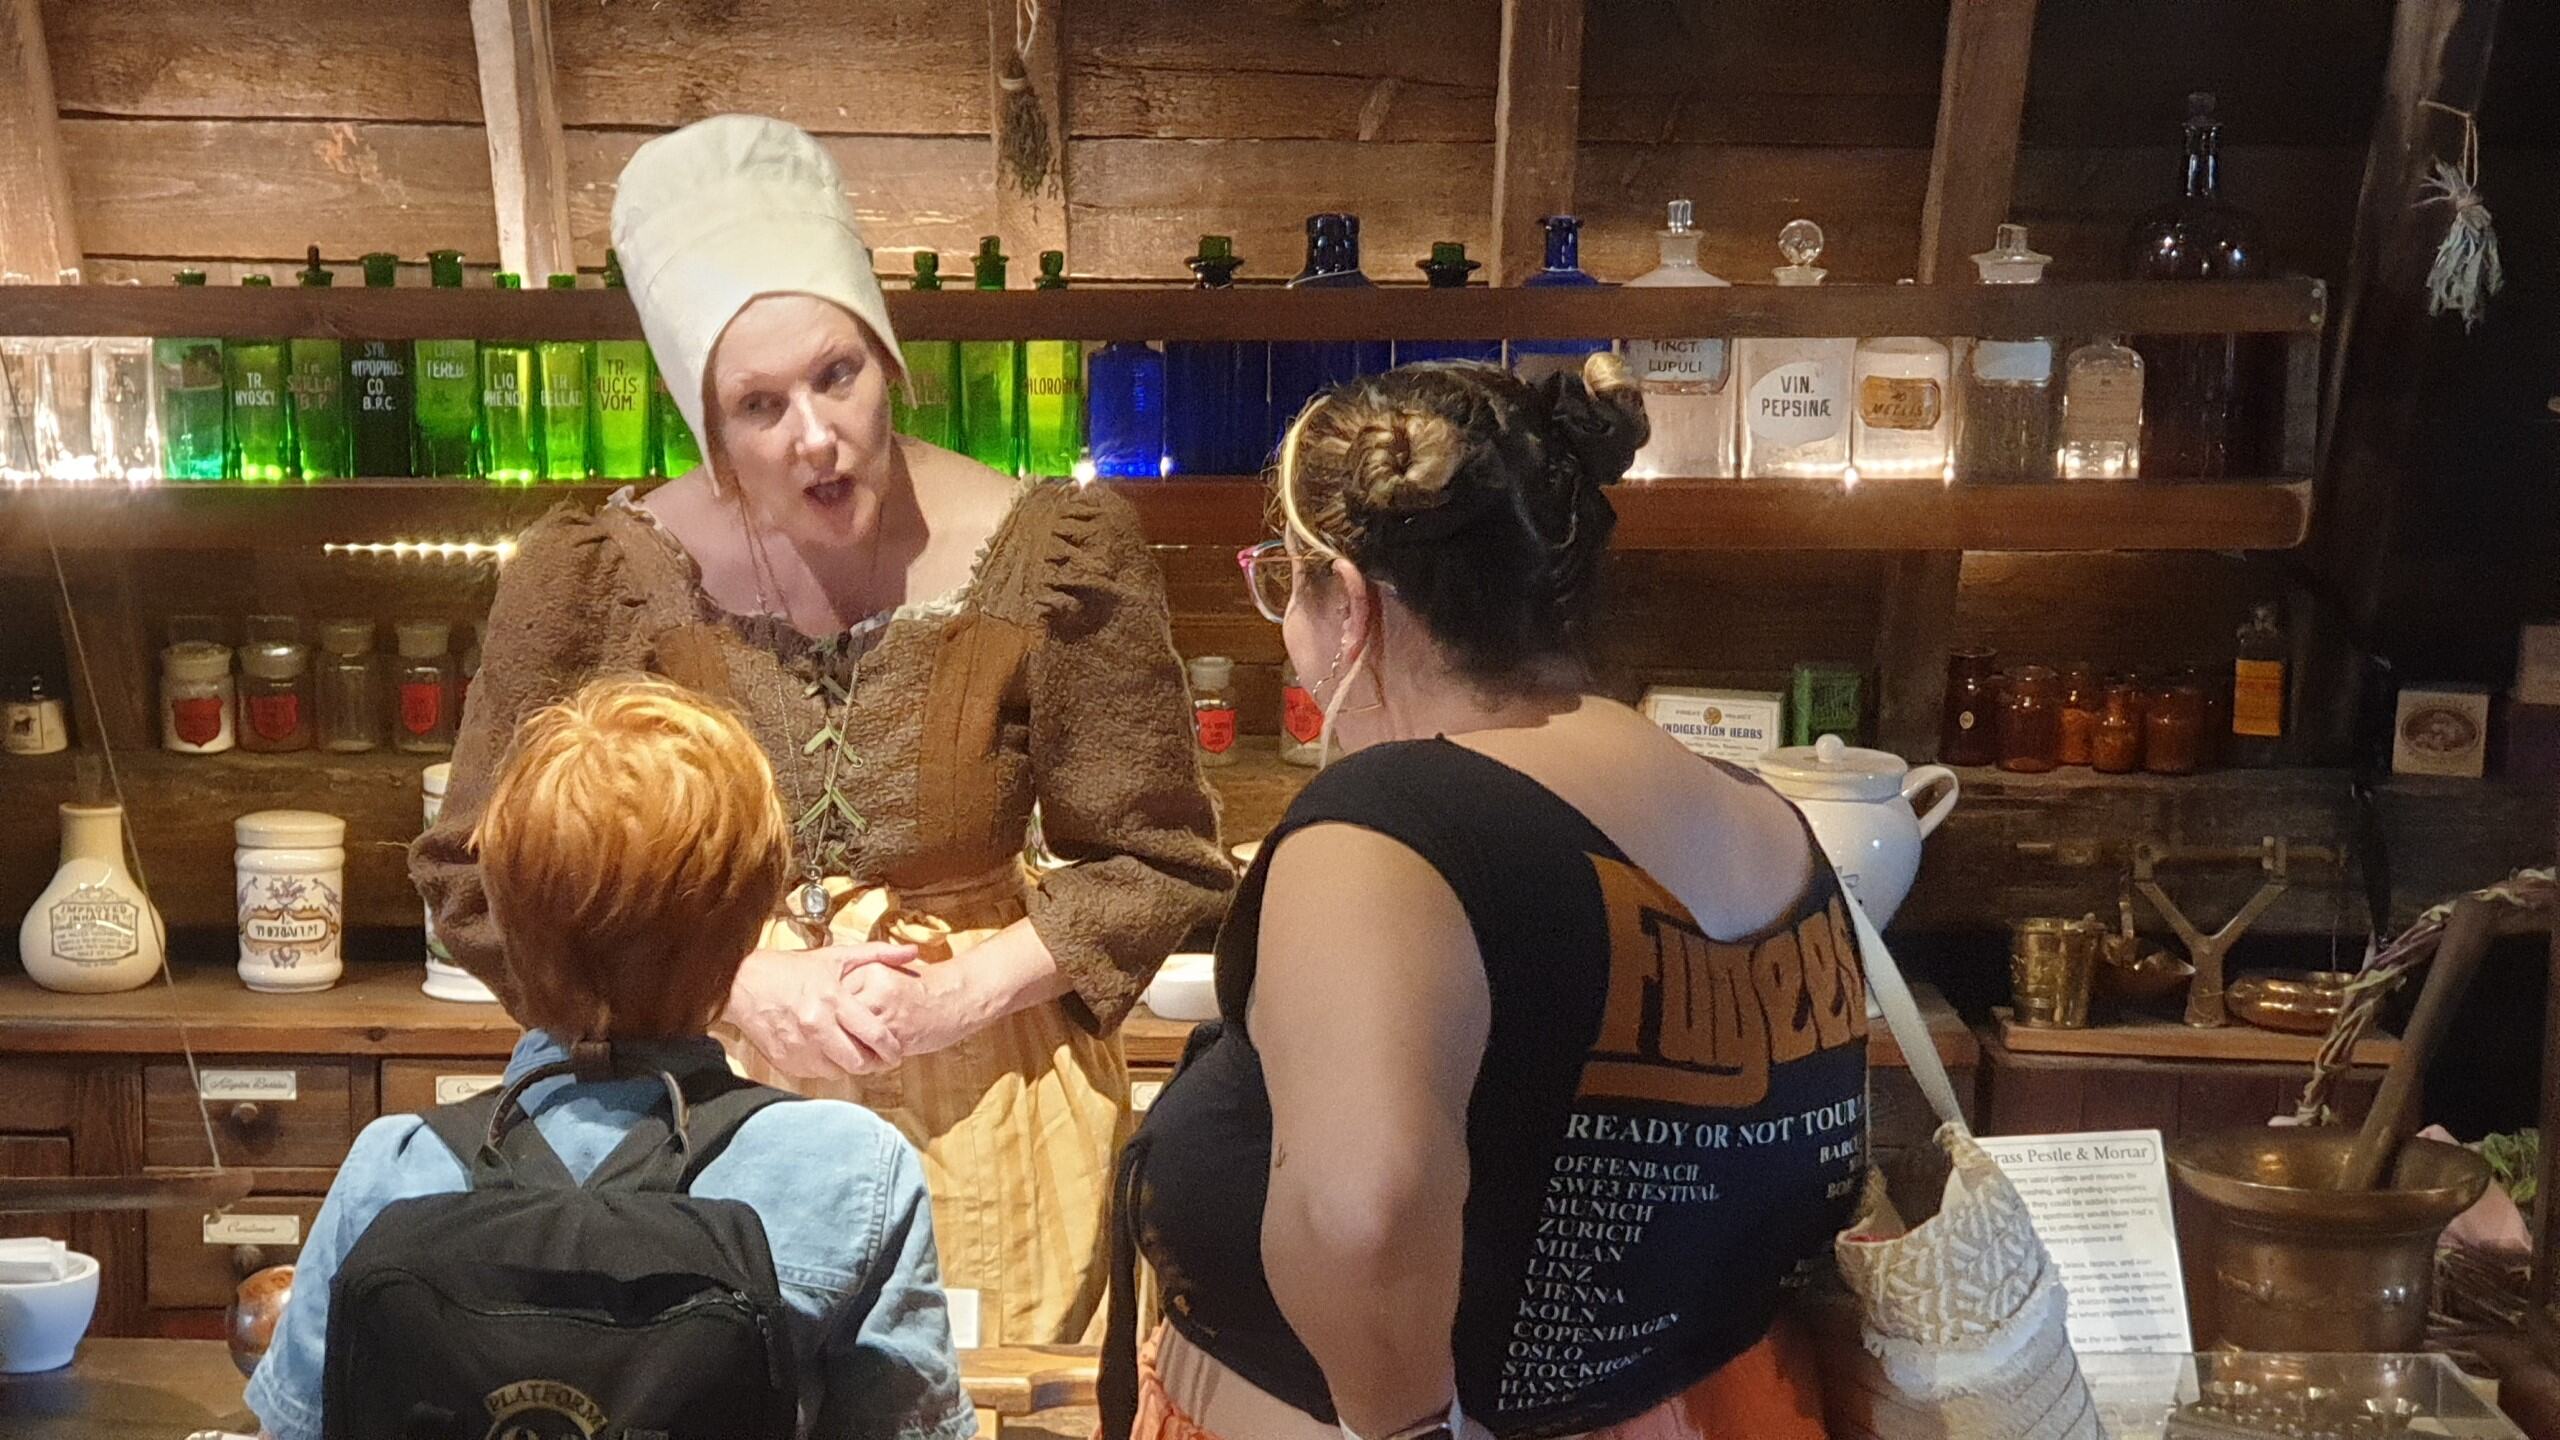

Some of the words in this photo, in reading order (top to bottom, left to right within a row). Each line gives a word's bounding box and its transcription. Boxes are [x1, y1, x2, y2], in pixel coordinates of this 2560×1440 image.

[1648, 359, 1702, 374] LUPULI
[1780, 375, 1815, 394] VIN.
[362, 396, 396, 412] B.P.C.
[1761, 397, 1832, 418] PEPSINÆ
[1662, 722, 1726, 737] INDIGESTION
[1729, 727, 1763, 740] HERBS
[1565, 1113, 1690, 1147] READY
[1695, 1124, 1729, 1149] OR
[1736, 1116, 1794, 1147] NOT
[1990, 1151, 2023, 1165] rass
[2027, 1148, 2073, 1163] Pestle
[2076, 1147, 2090, 1161] &
[2094, 1145, 2149, 1161] Mortar
[1553, 1155, 1700, 1182] OFFENBACH
[1626, 1181, 1720, 1203] FESTIVAL
[1542, 1196, 1655, 1222] MUNICH
[1537, 1217, 1643, 1243] ZURICH
[1534, 1237, 1625, 1263] MILAN
[1527, 1258, 1593, 1282] LINZ
[1523, 1279, 1625, 1304] VIENNA
[1512, 1312, 1682, 1343] COPENHAGEN
[1501, 1346, 1653, 1379] STOCKHO
[1508, 1340, 1584, 1361] OSLO
